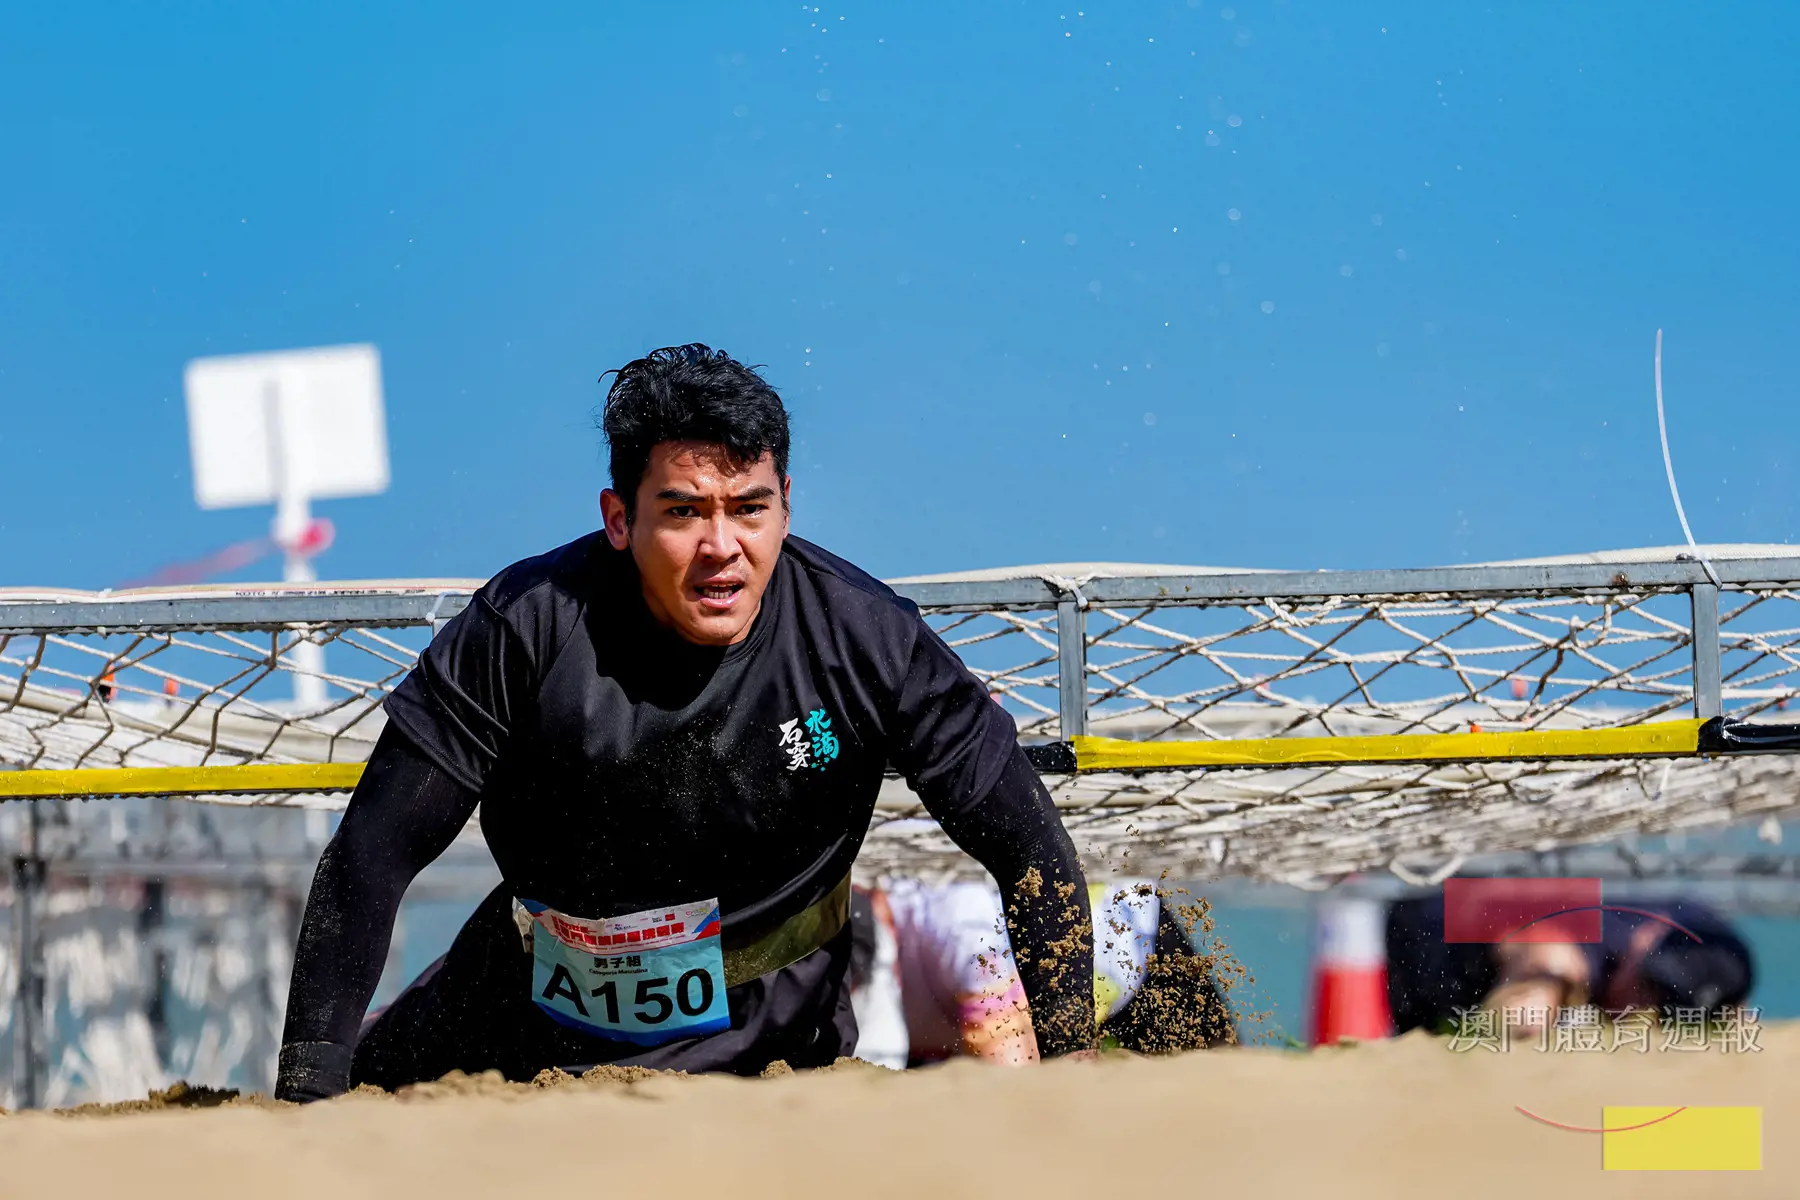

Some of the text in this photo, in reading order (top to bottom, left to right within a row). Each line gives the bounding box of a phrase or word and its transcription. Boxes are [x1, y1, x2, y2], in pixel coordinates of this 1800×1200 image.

[778, 717, 811, 771] 石穿
[804, 708, 840, 759] 水滴
[588, 968, 617, 976] Categoria
[593, 955, 642, 969] 男子組
[541, 963, 714, 1025] A150
